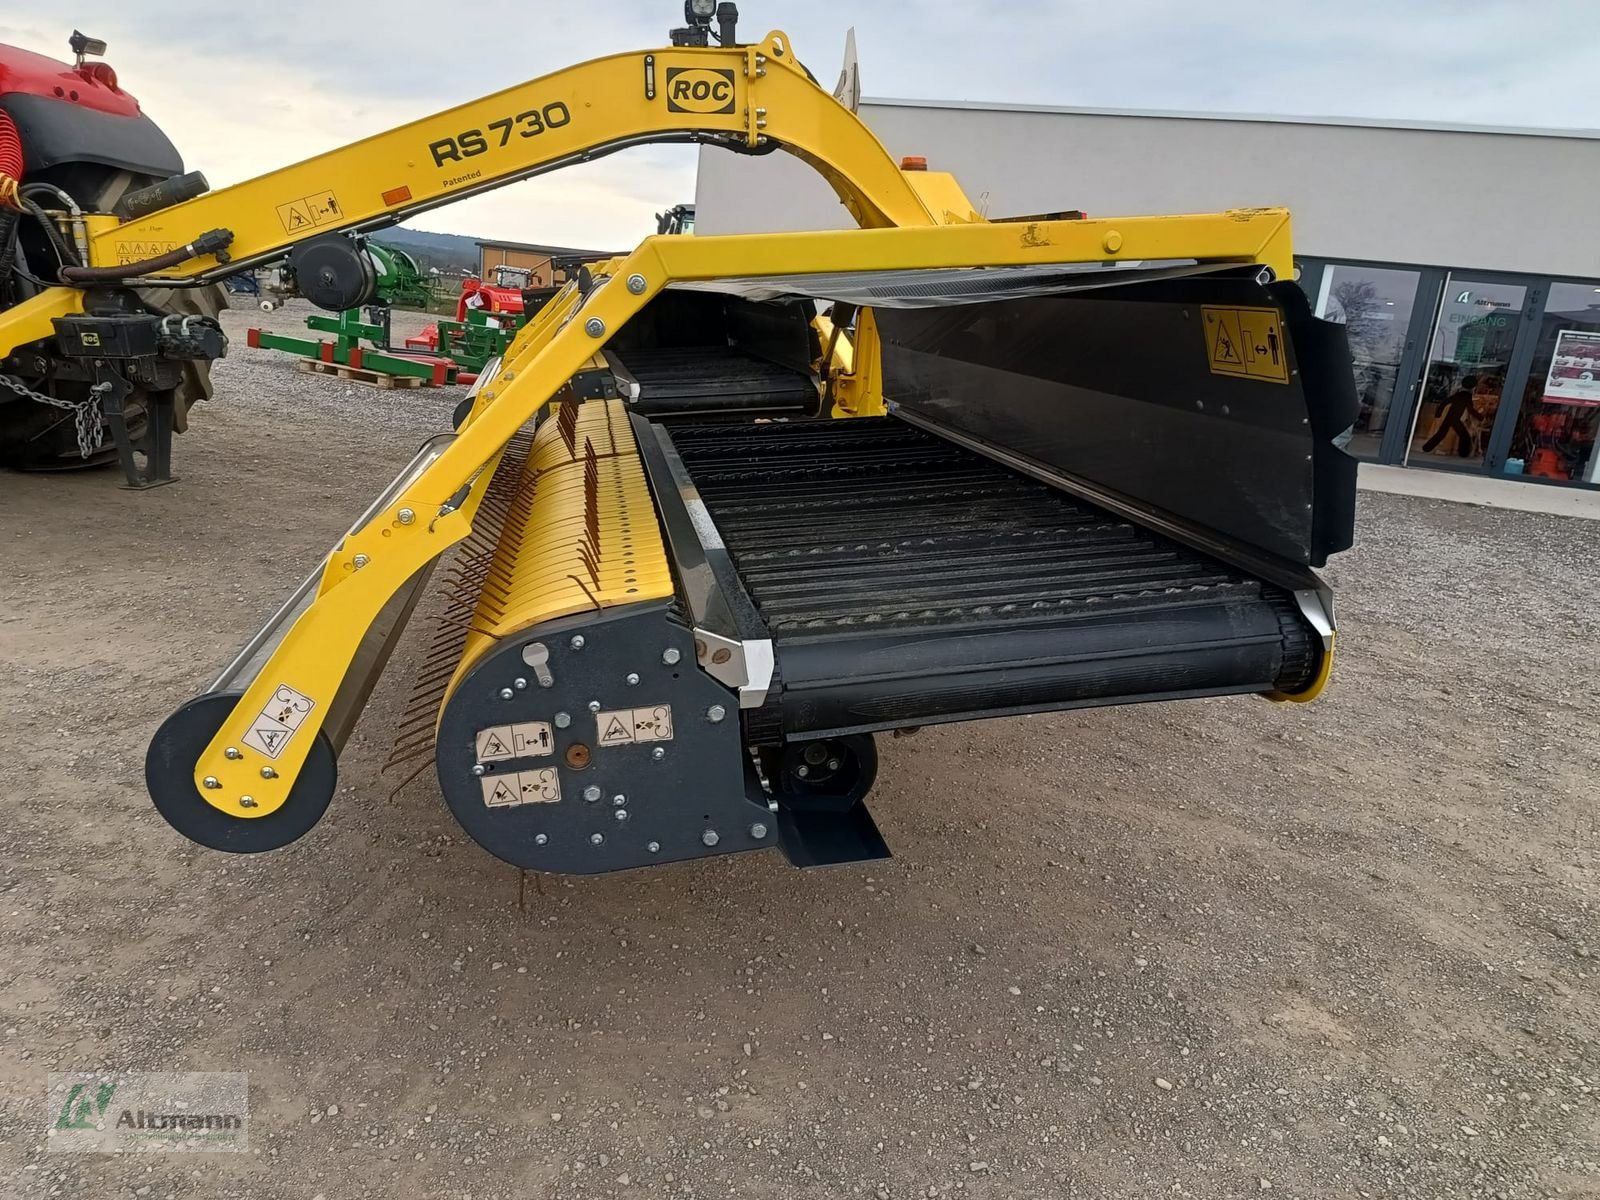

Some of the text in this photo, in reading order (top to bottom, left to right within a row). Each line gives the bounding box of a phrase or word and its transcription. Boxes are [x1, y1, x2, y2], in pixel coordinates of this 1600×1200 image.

[673, 80, 730, 101] ROC
[428, 101, 571, 168] RS 730
[442, 169, 482, 188] Patented
[1449, 313, 1506, 327] EINGANG
[83, 335, 99, 343] ROC
